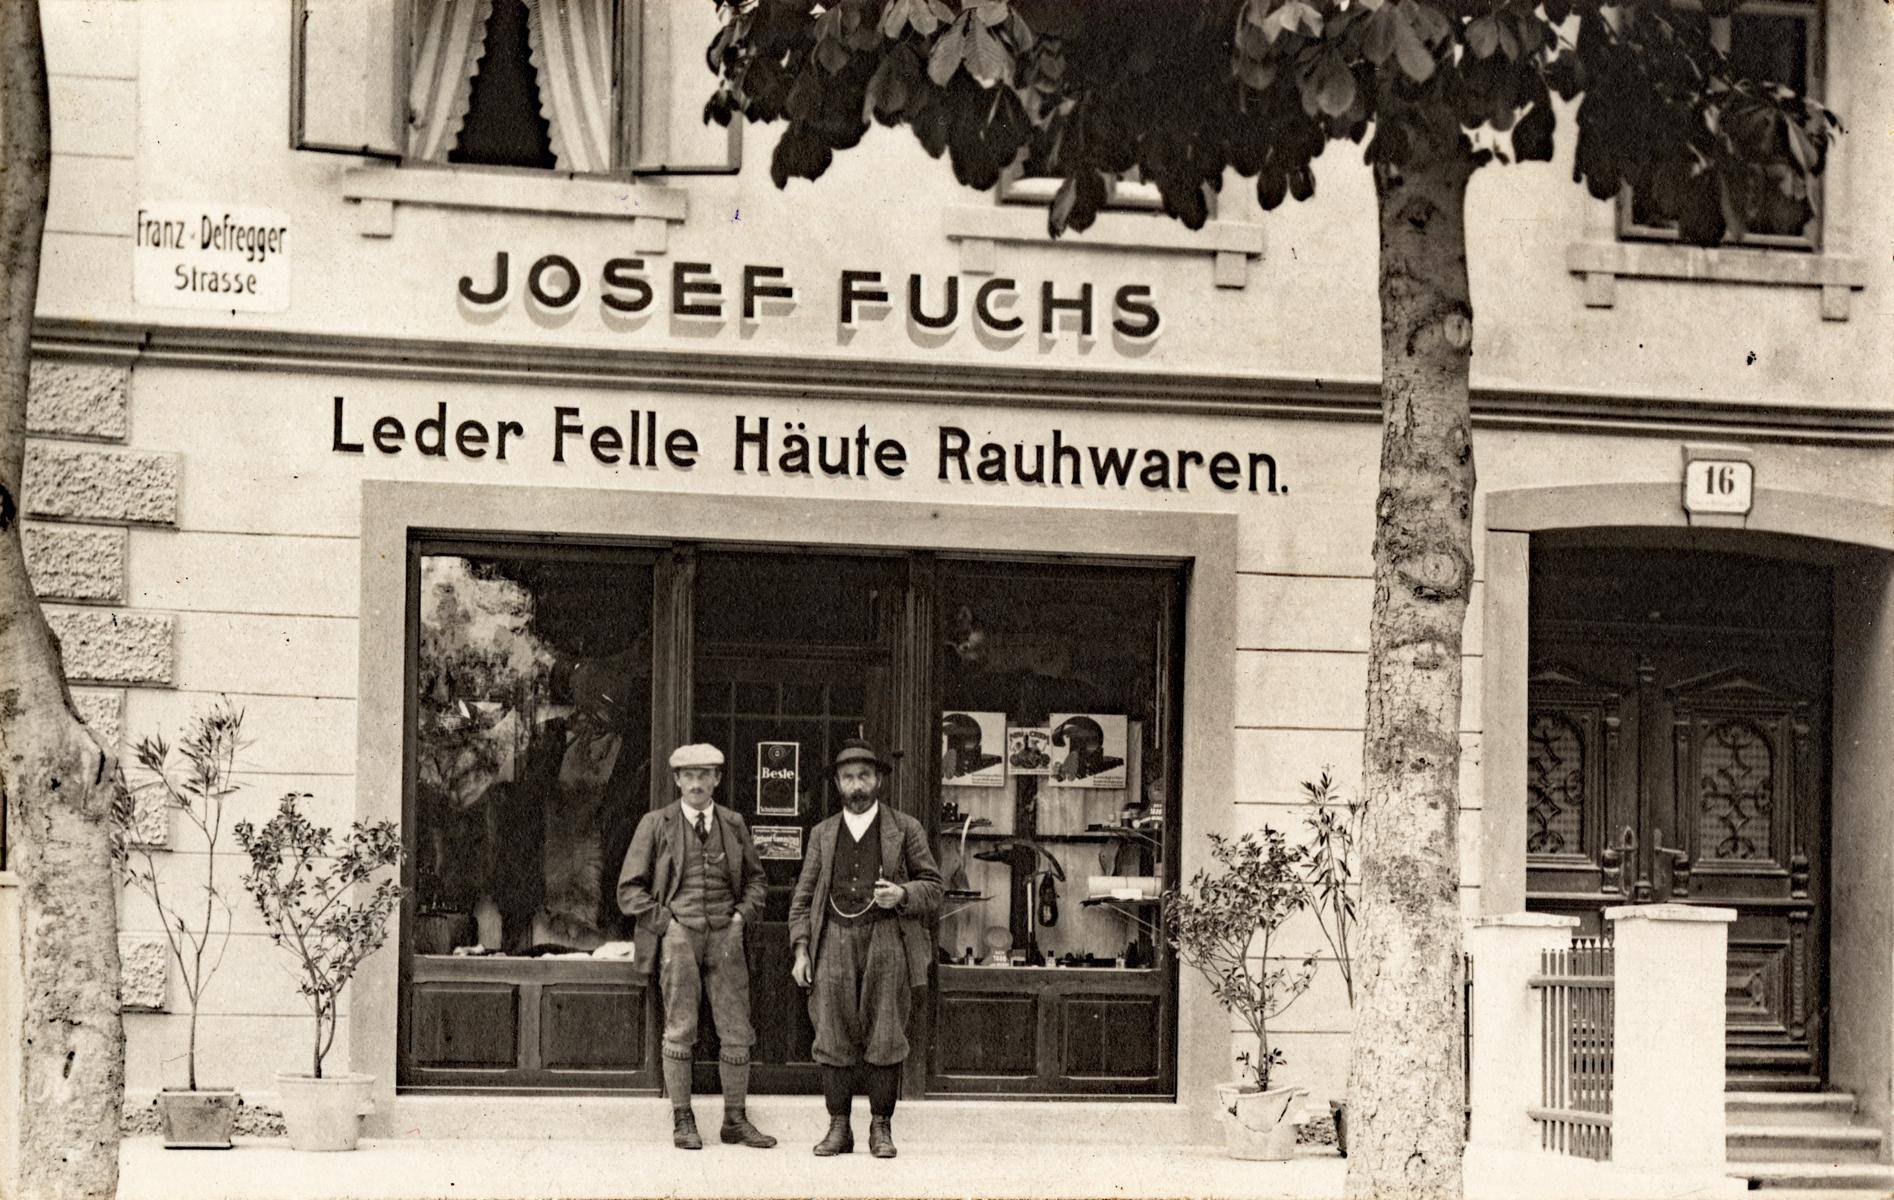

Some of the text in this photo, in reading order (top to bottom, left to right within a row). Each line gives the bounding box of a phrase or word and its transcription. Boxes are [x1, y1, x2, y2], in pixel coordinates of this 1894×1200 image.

[201, 213, 287, 262] Defregger
[174, 264, 257, 294] Strasse
[458, 251, 1160, 338] JOSEF FUCHS
[332, 396, 1289, 493] Leder Felle Häute Rauhwaren.
[1705, 465, 1735, 495] 16
